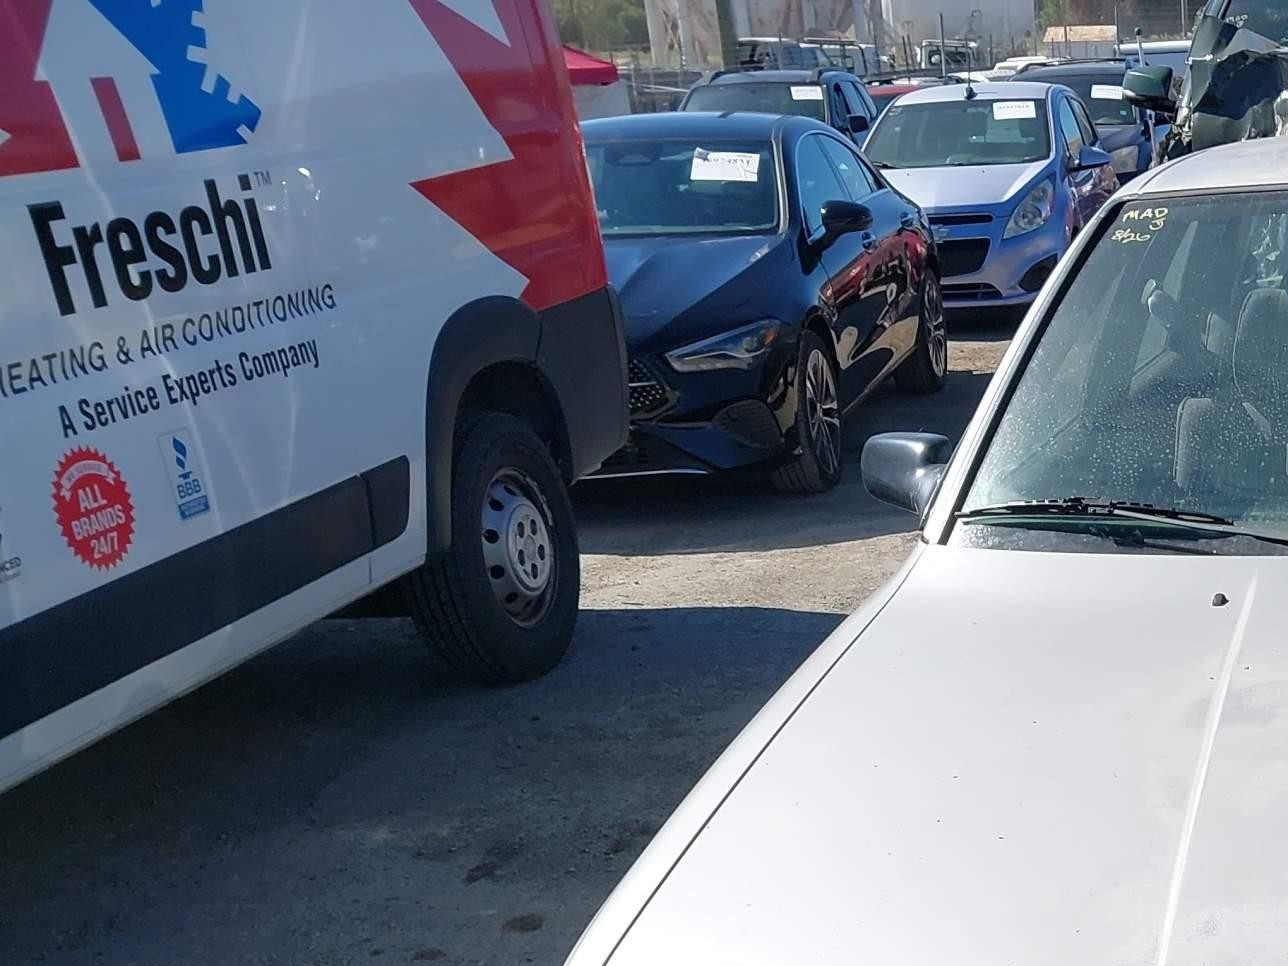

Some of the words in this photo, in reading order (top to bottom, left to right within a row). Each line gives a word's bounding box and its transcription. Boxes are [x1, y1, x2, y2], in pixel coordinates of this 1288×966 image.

[1122, 207, 1169, 223] MAD
[26, 174, 272, 317] Freschi
[116, 336, 135, 365] &
[140, 323, 179, 360] AIR
[182, 283, 338, 347] CONDITIONING
[57, 404, 78, 439] A
[78, 386, 161, 432] Service
[162, 358, 238, 407] Experts
[239, 338, 320, 382] Company
[77, 484, 107, 512] ALL
[177, 479, 202, 499] BBB
[71, 504, 126, 541] BRANDS
[91, 532, 120, 559] 24/7
